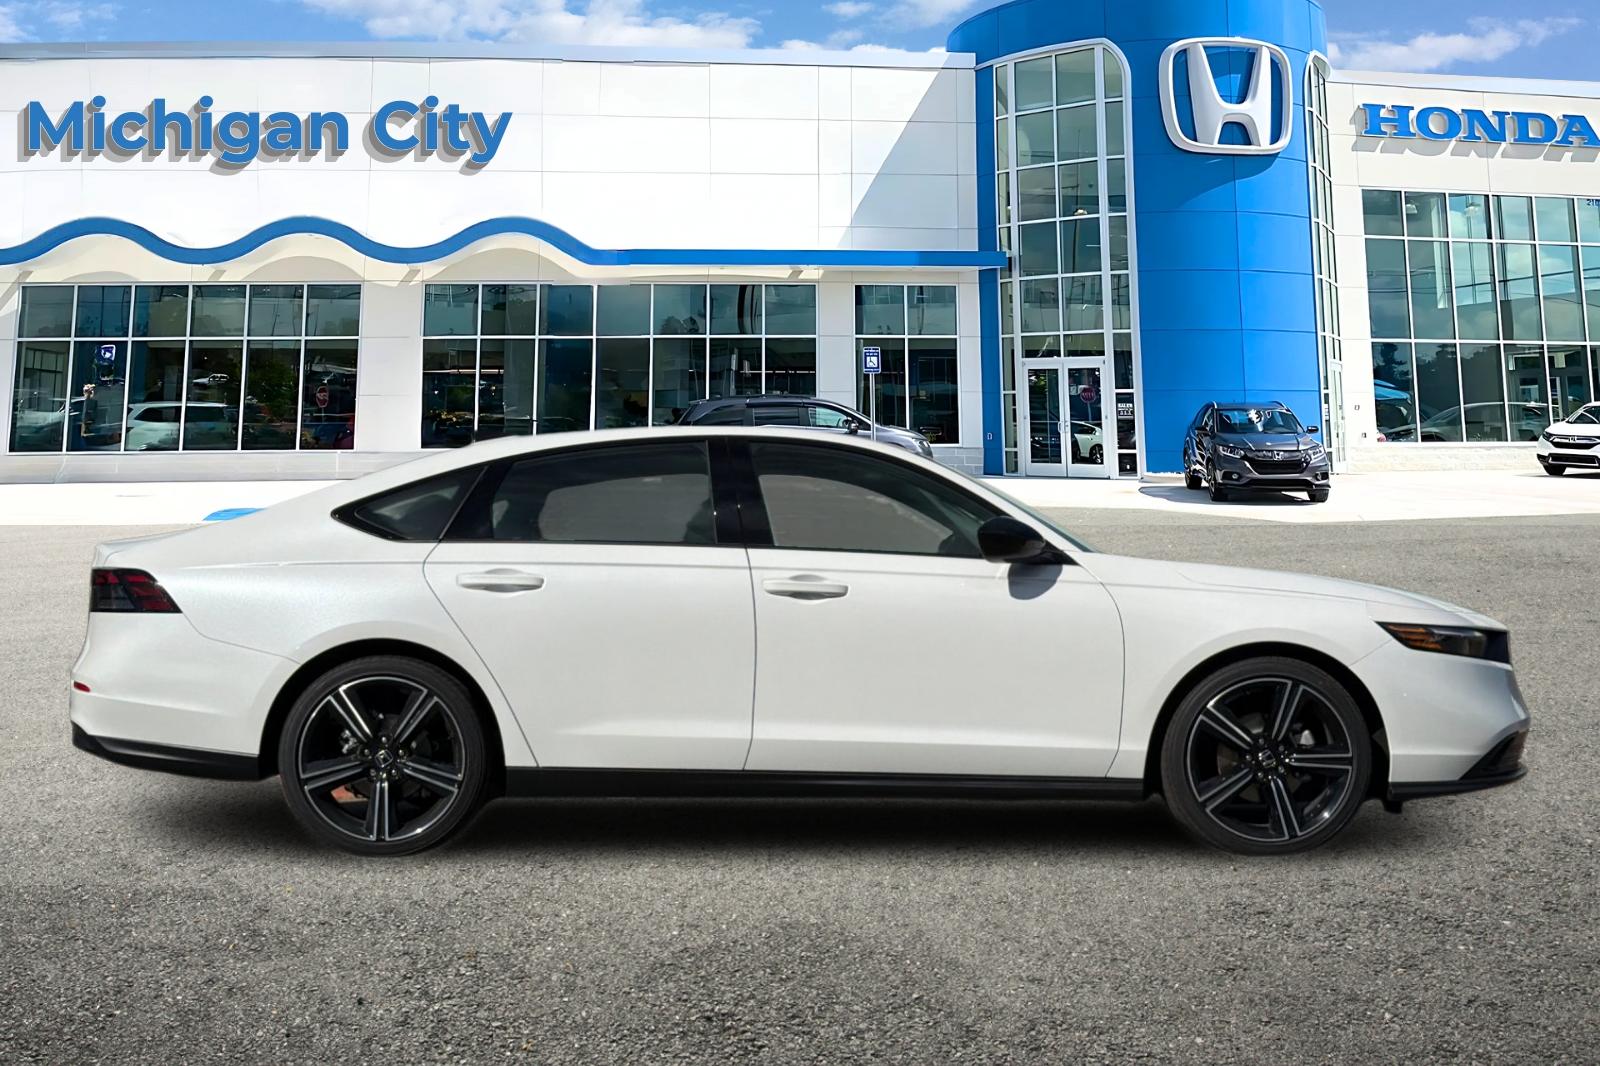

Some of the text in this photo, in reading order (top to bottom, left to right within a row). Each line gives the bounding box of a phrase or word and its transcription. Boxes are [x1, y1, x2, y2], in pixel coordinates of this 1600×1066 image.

[27, 95, 512, 165] Michigan City
[1361, 102, 1600, 148] HONDA
